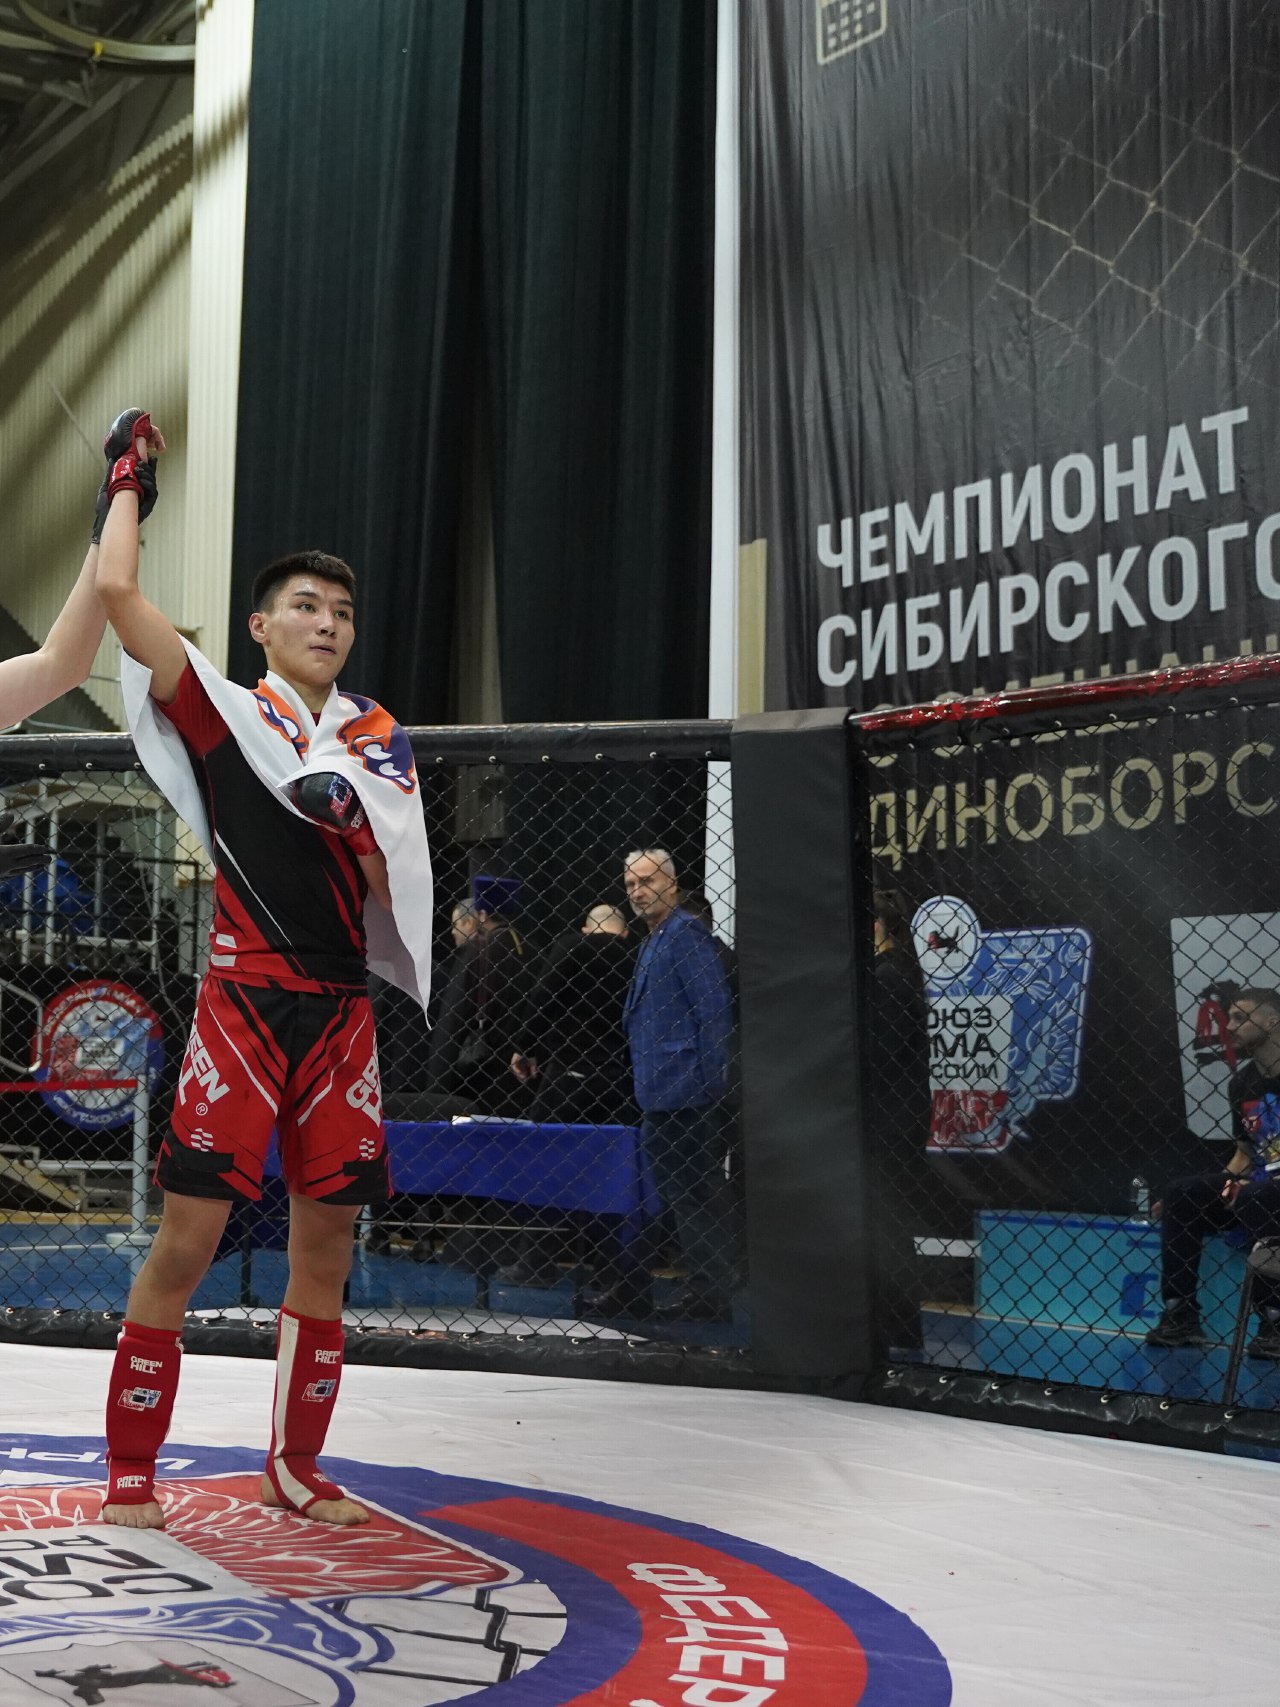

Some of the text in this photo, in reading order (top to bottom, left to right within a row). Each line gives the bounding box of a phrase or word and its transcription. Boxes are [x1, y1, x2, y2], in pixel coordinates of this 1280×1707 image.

[816, 405, 1249, 589] ЧЕМПИОНАТ
[929, 1033, 996, 1059] МА
[130, 1355, 163, 1368] GREEN
[130, 1361, 157, 1375] HILL
[626, 1562, 789, 1707] ФЕДЕР
